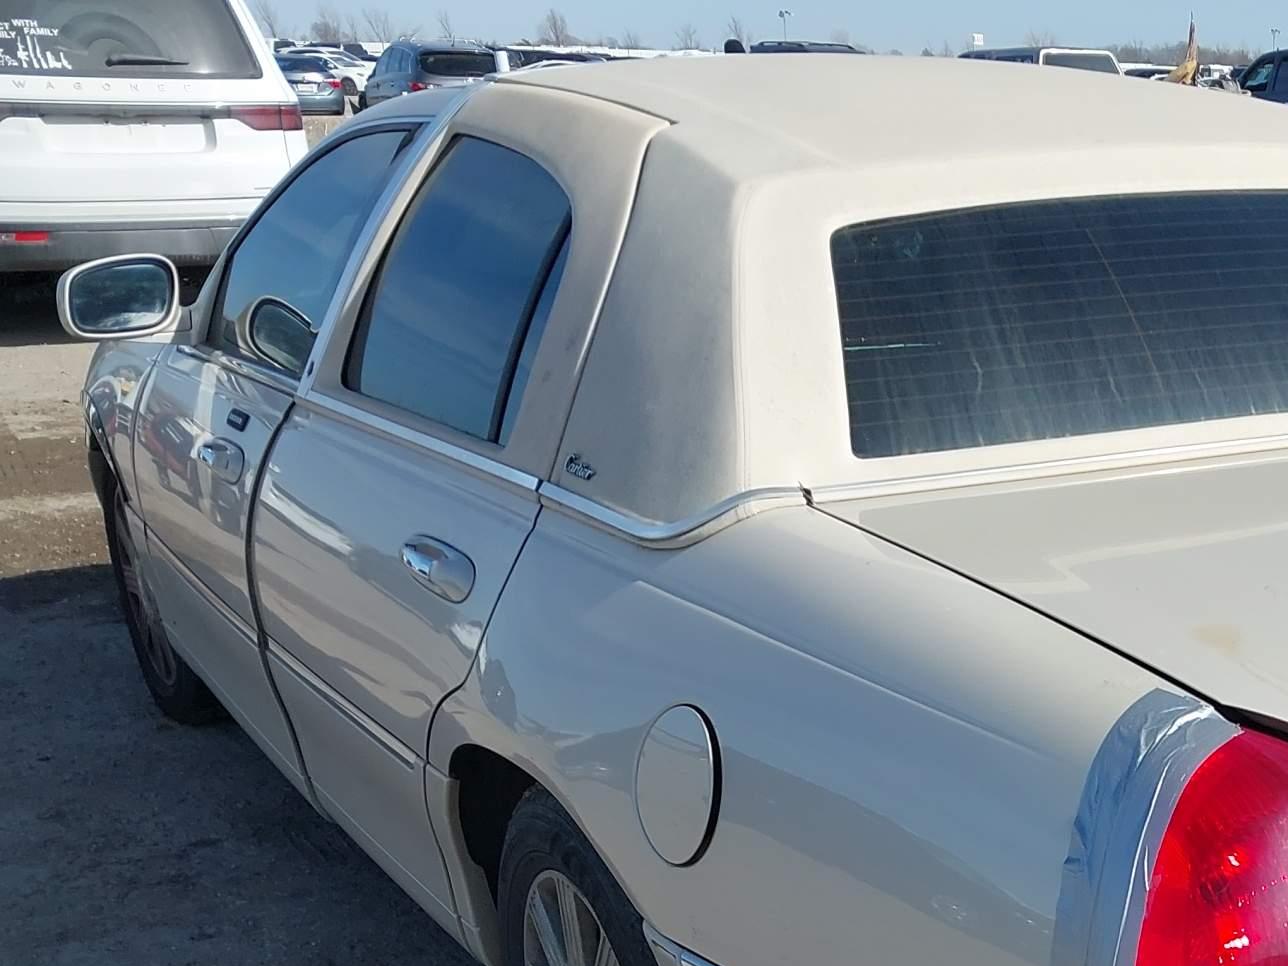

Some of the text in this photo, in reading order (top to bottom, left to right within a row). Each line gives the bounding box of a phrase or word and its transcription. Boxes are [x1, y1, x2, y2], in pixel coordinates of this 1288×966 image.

[11, 18, 38, 27] WITH
[23, 27, 58, 36] FAMILY
[564, 454, 594, 480] Cartier
